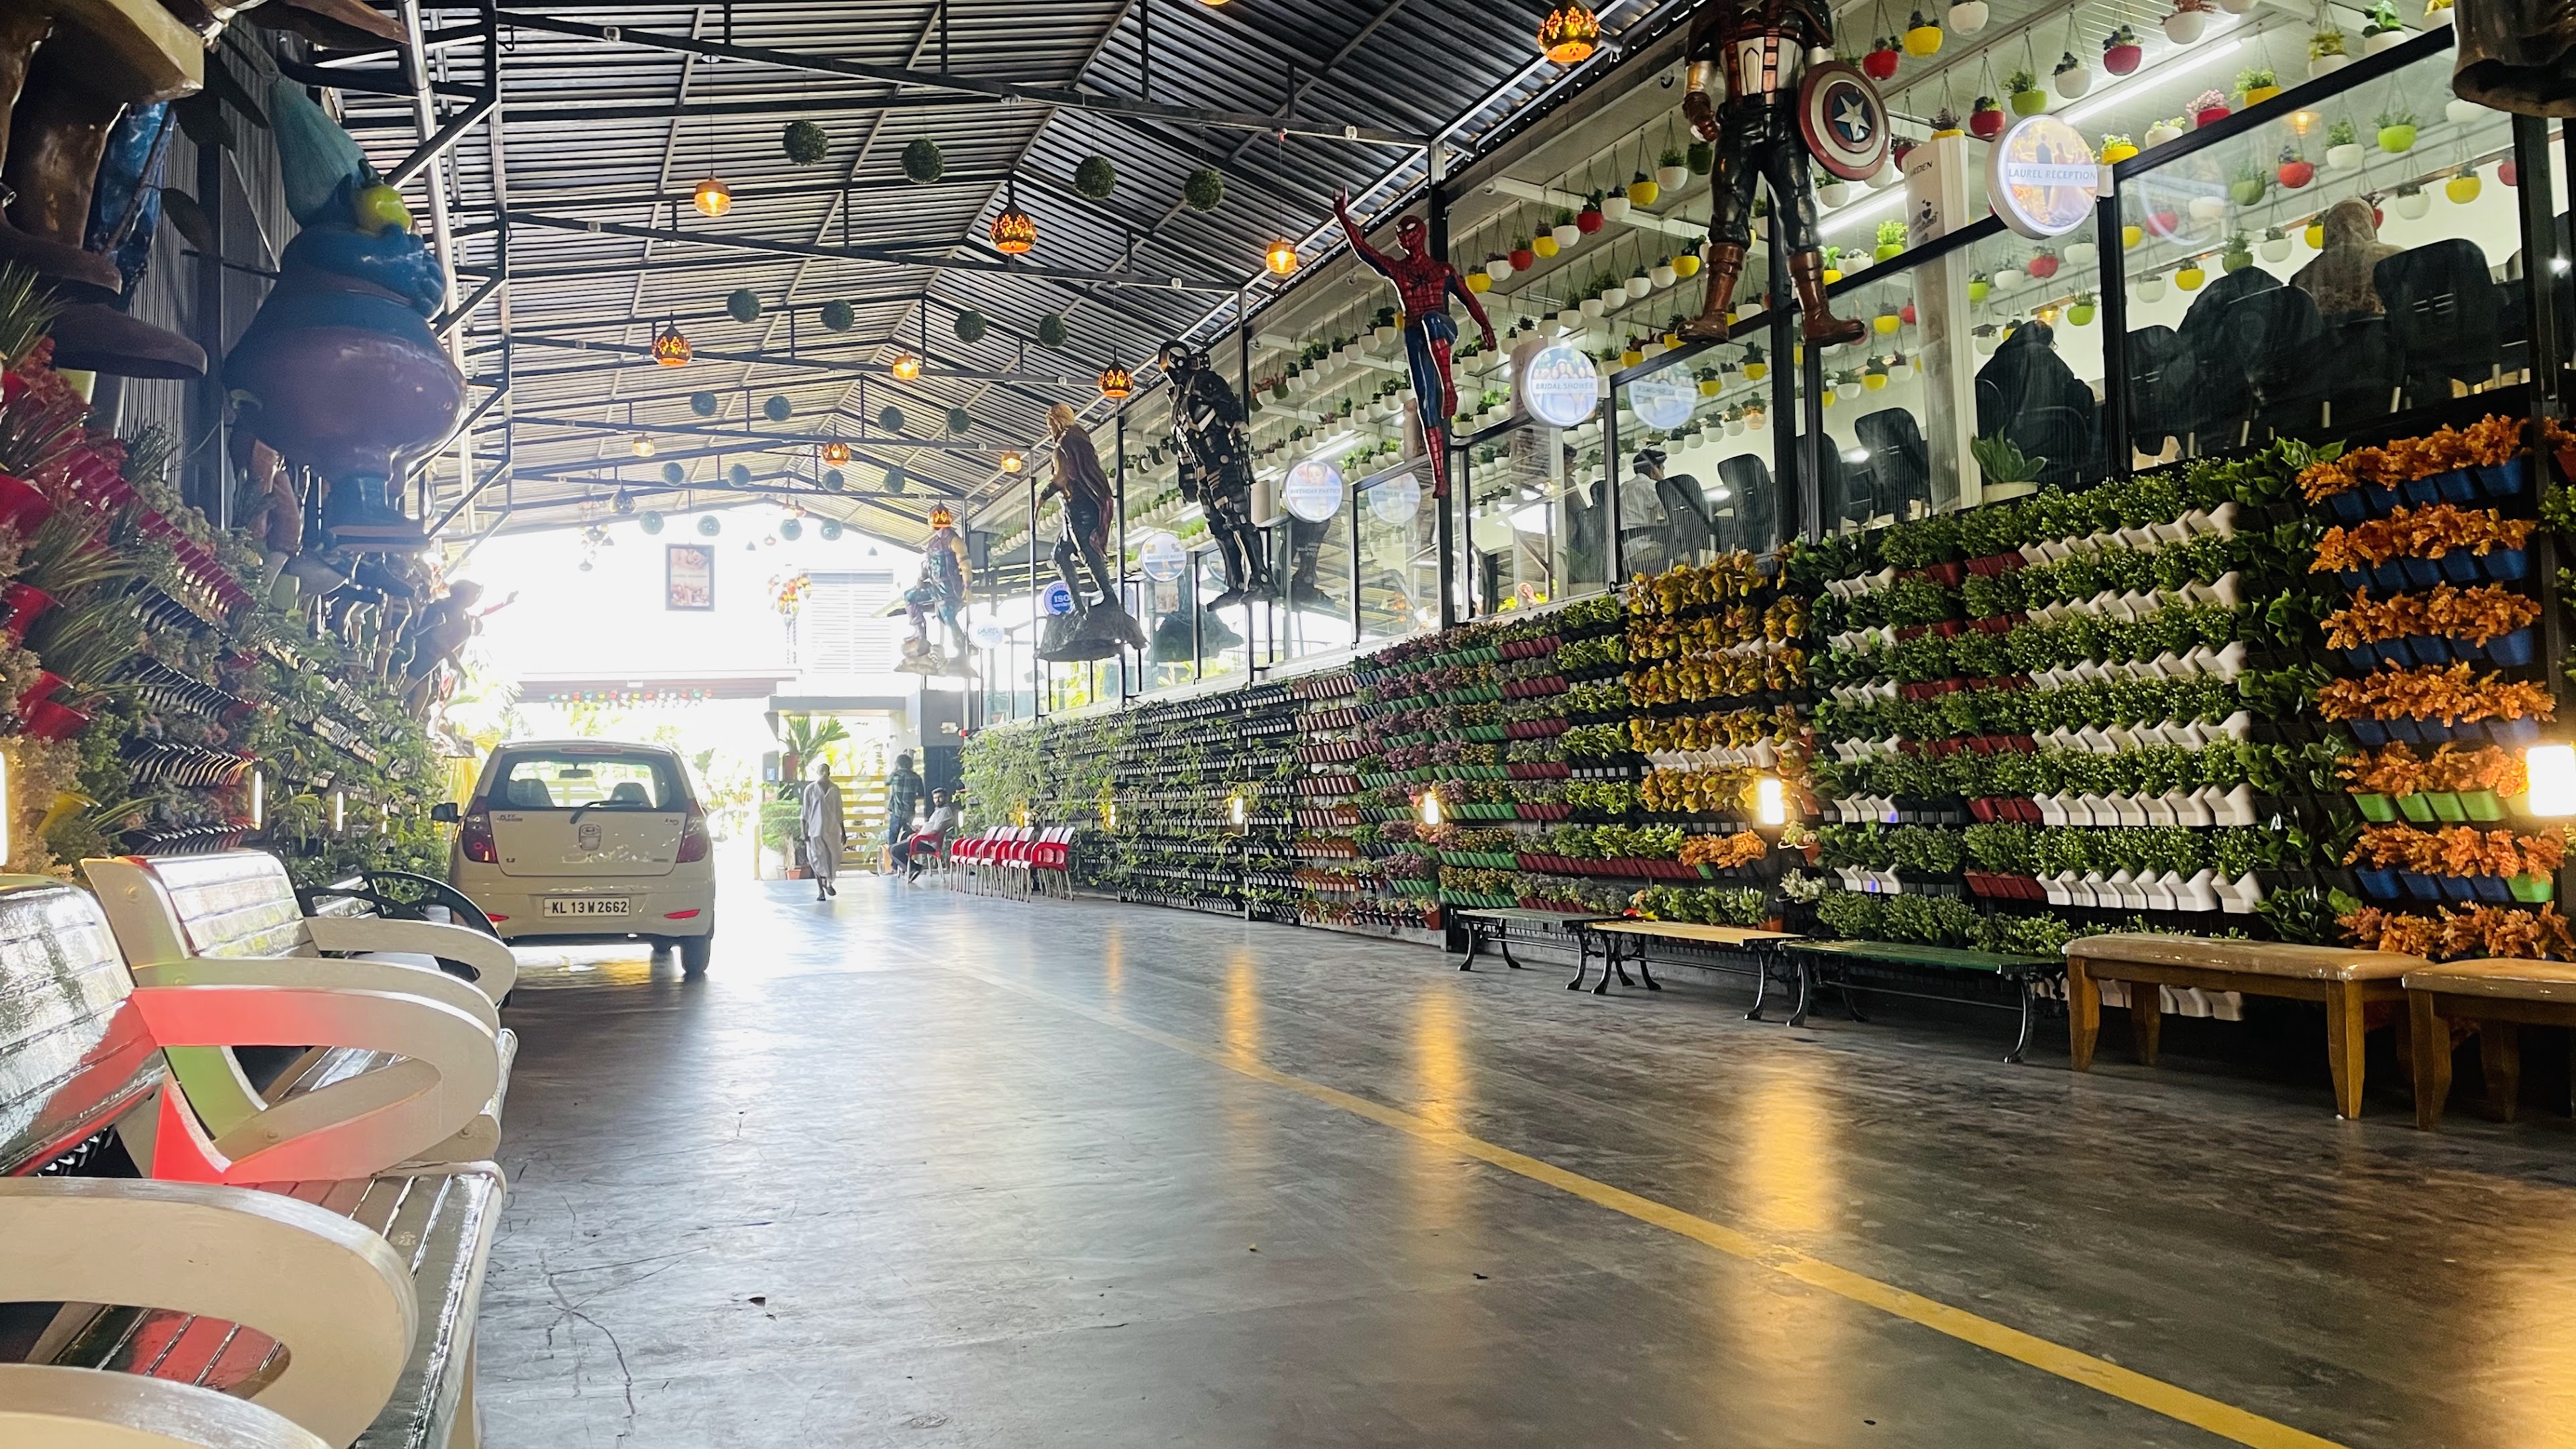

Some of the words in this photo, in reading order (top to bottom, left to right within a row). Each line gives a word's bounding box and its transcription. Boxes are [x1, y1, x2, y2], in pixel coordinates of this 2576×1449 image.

[2008, 168, 2042, 178] LAUREL
[2045, 170, 2096, 180] RECEPTION
[1054, 594, 1070, 602] ISO
[552, 902, 567, 913] KL
[571, 902, 584, 913] 13
[588, 902, 594, 913] W
[598, 901, 627, 913] 2662
